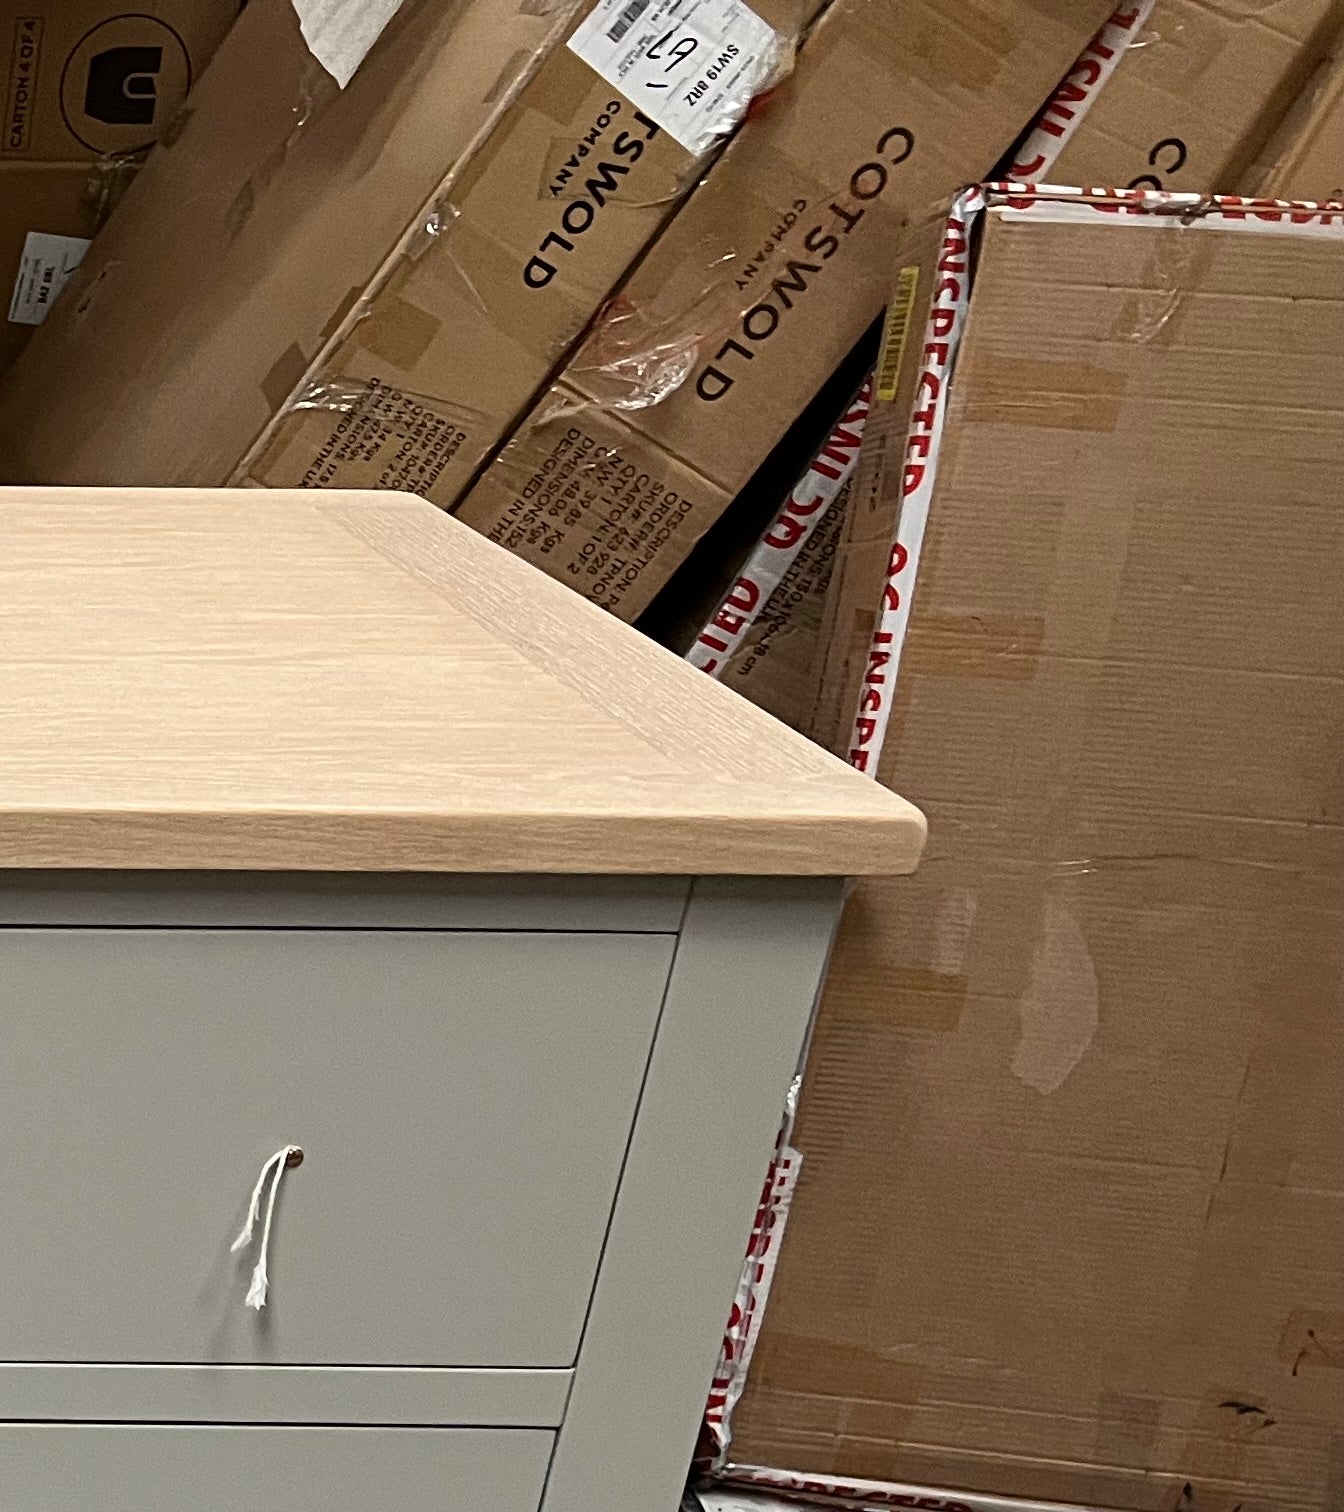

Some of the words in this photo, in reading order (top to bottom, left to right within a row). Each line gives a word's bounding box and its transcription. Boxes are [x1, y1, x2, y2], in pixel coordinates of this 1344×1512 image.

[704, 42, 740, 82] SW19
[8, 75, 28, 148] CARTON
[19, 34, 34, 59] OF
[682, 78, 710, 107] 8RZ
[550, 100, 621, 199] COMPANY
[695, 126, 913, 402] COTSWOLD
[734, 198, 808, 291] COMPANY
[519, 425, 582, 501] DESIGNED
[506, 497, 526, 518] IN
[764, 494, 824, 549] QC
[523, 518, 551, 548] Kgs
[536, 526, 566, 557] Kgs
[574, 539, 597, 565] OF
[772, 567, 799, 599] THE
